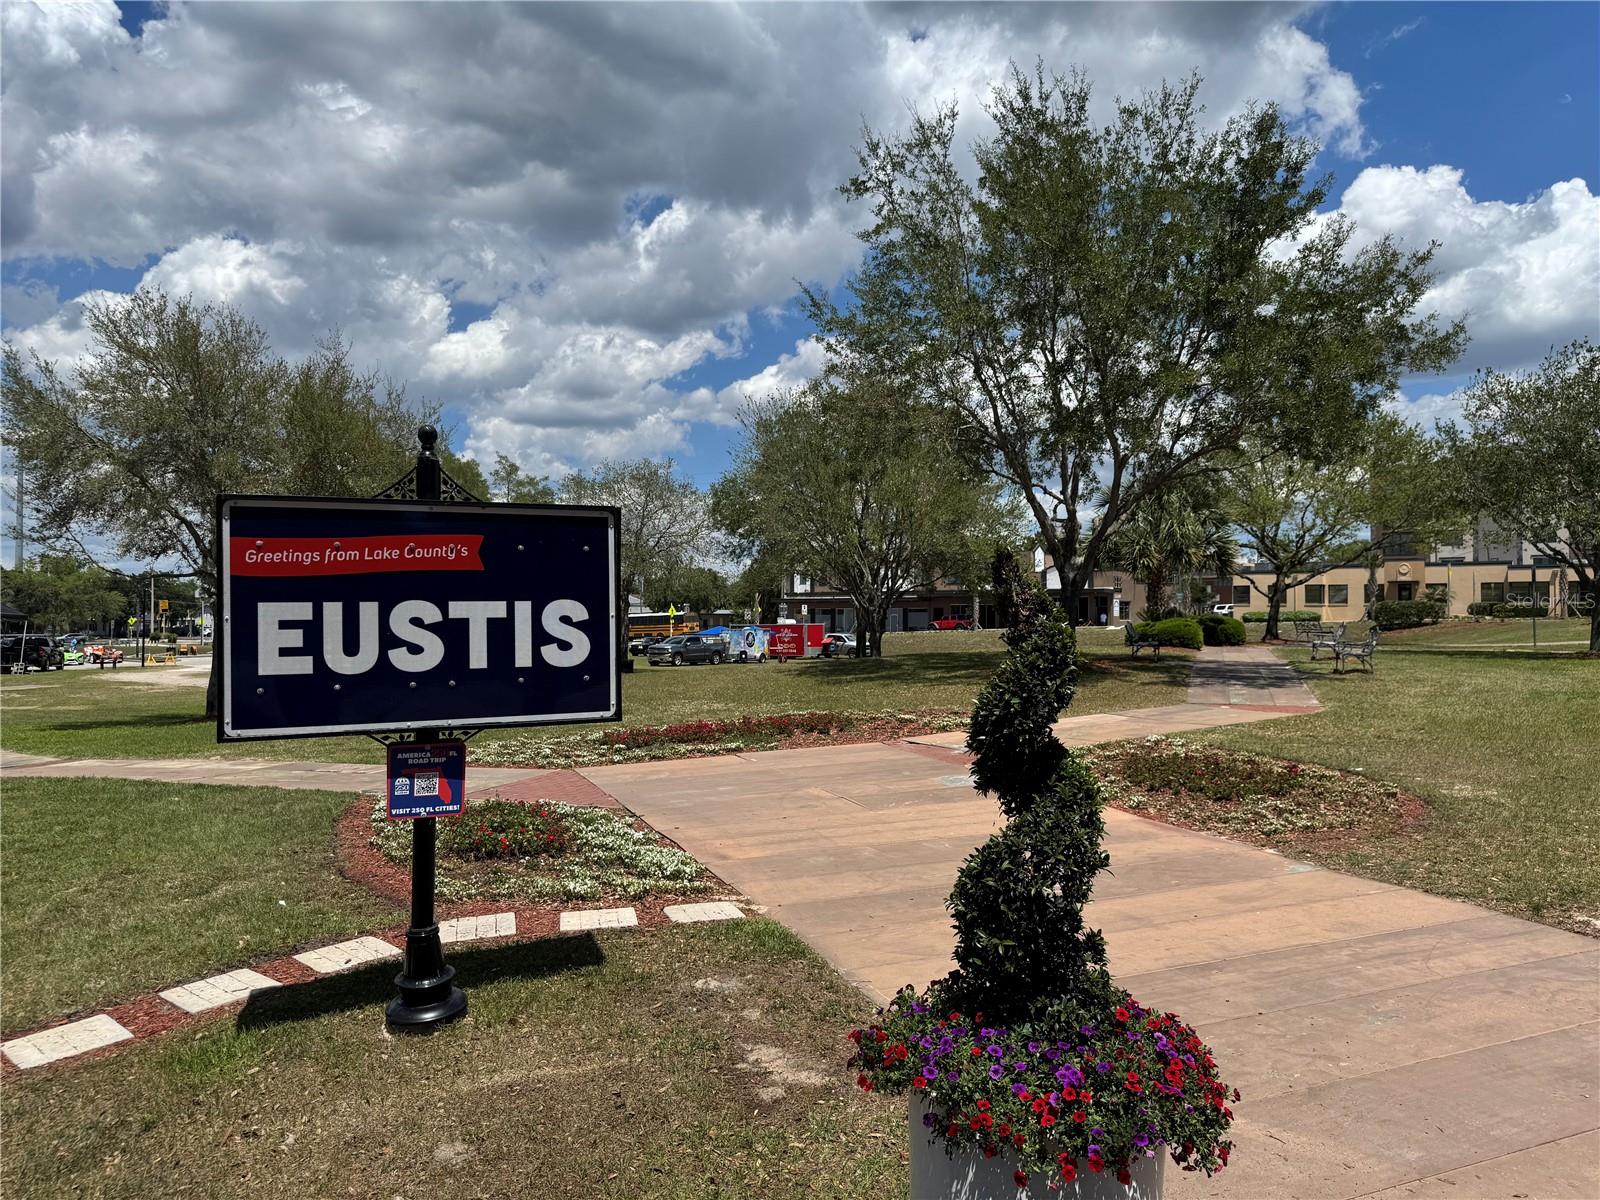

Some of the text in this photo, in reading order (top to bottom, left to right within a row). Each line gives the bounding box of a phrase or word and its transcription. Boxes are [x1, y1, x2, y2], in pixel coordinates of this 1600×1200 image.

[245, 544, 469, 565] Greetings from Lake County's
[257, 599, 591, 676] EUSTIS
